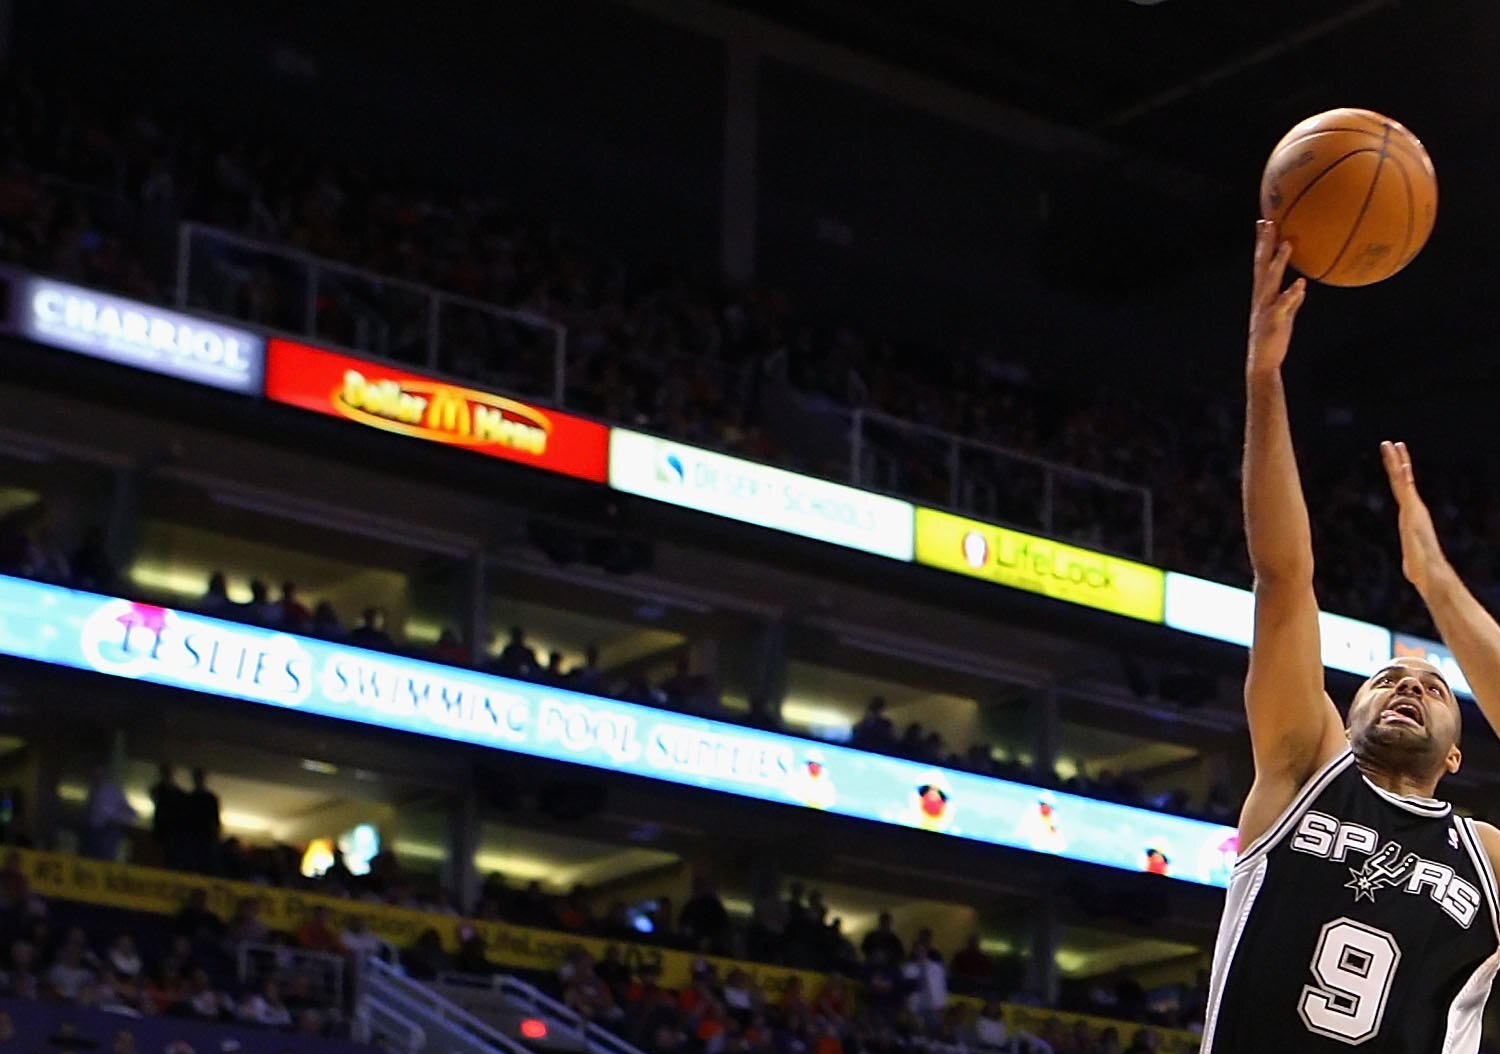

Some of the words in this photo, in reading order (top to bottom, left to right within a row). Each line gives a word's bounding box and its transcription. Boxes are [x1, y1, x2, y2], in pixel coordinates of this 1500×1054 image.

[34, 289, 249, 369] CHARRIOL
[344, 368, 427, 424] Dollar
[996, 535, 1112, 588] LifeLock
[334, 661, 525, 732] SWIMMING
[546, 706, 634, 753] POOL
[655, 733, 790, 779] SUPPLIES
[1290, 810, 1481, 929] SPURS
[1297, 916, 1401, 1045] 9
